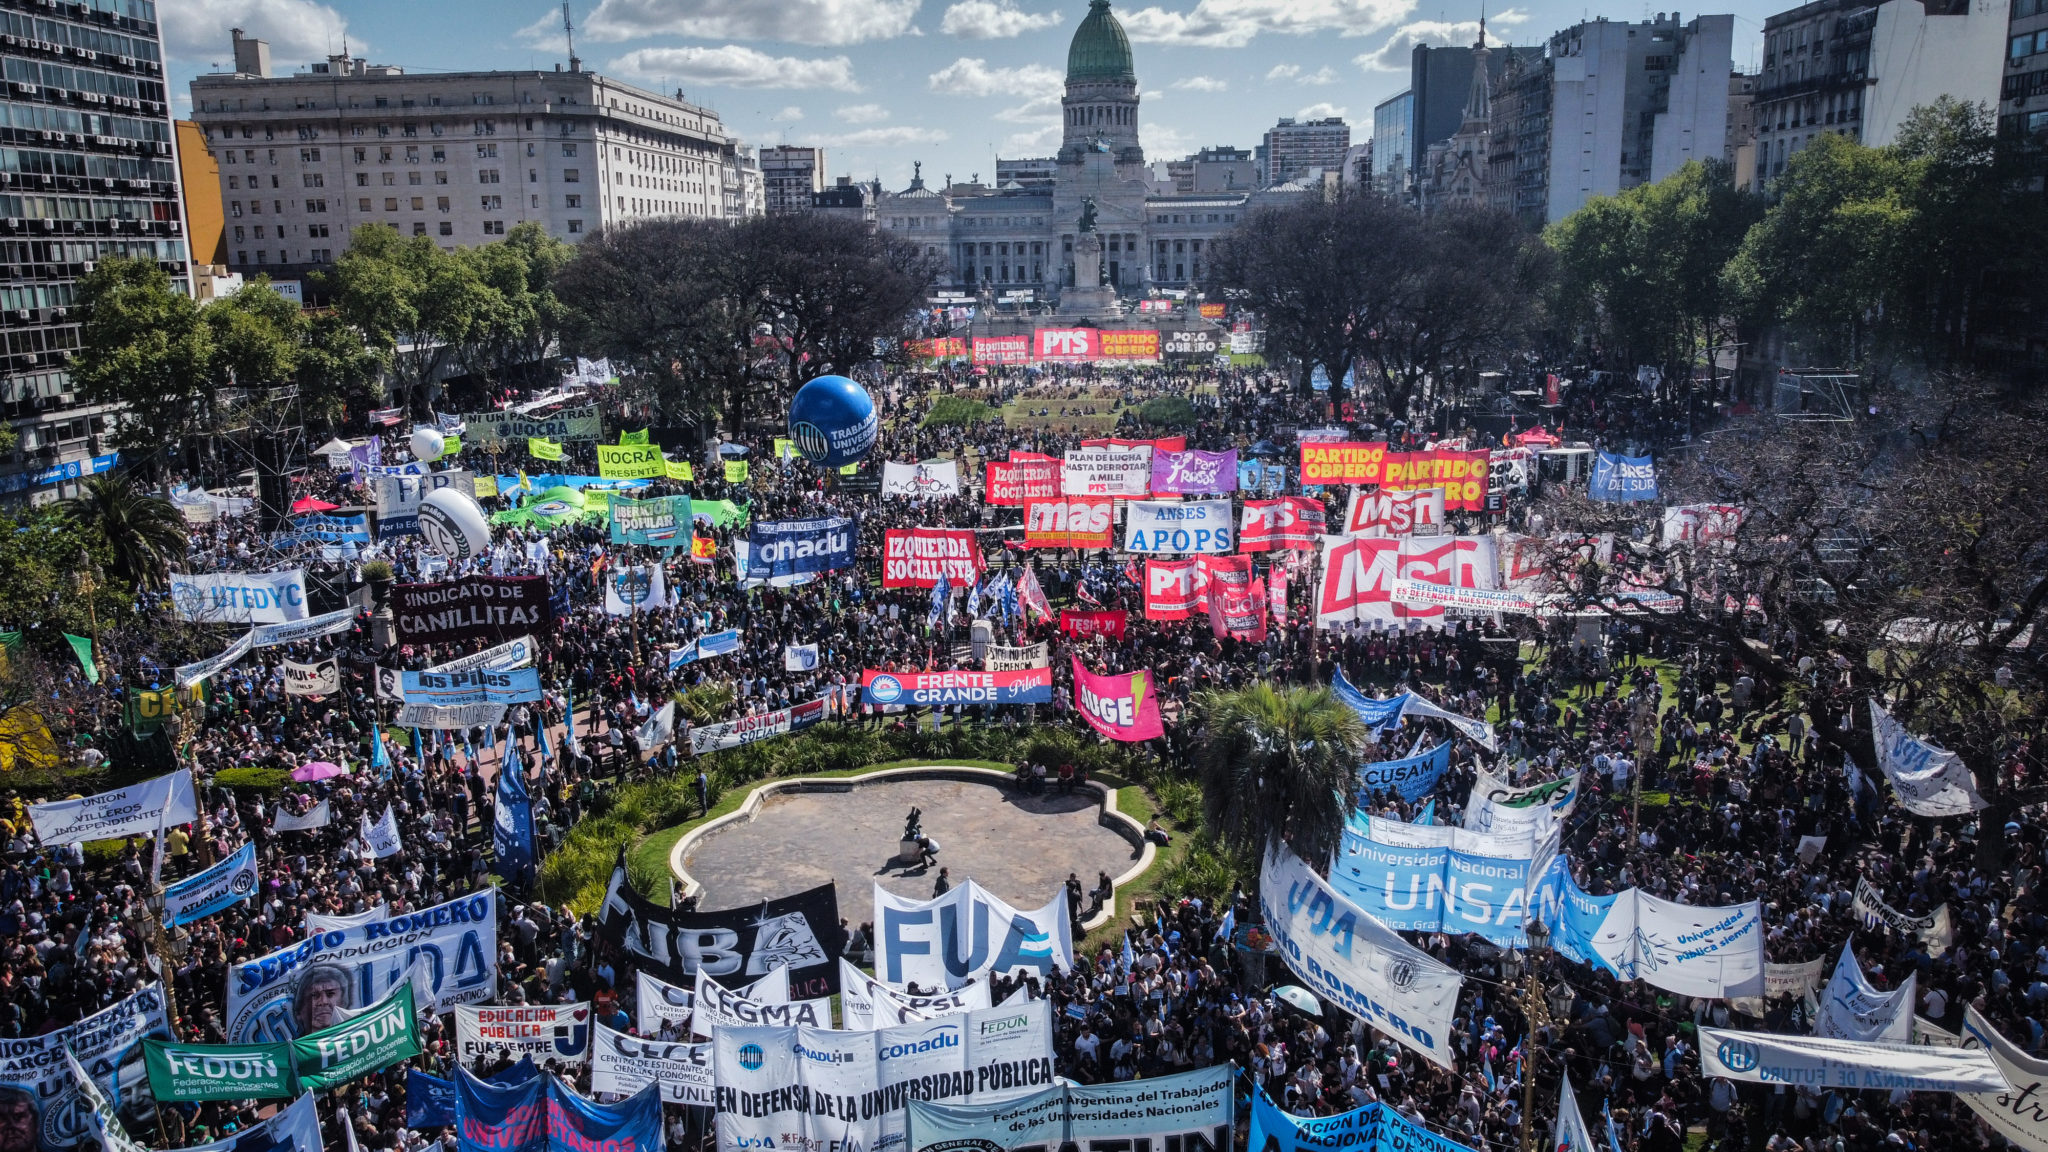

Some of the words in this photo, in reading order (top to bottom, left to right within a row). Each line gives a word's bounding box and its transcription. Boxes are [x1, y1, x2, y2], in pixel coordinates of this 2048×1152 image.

[975, 341, 1026, 352] IZQUIERDA
[1043, 331, 1089, 355] PTS
[1102, 333, 1158, 345] PARTIDO
[1105, 345, 1156, 355] OBRERO
[486, 413, 505, 423] UN
[513, 421, 568, 437] UOCRA
[601, 451, 656, 465] UOCRA
[1303, 448, 1383, 464] PARTIDO
[604, 466, 659, 478] PRESENTE
[995, 467, 1051, 483] IZQUIERDA
[1306, 463, 1379, 479] OBRERO
[1385, 458, 1488, 482] PARTIDO
[993, 483, 1054, 499] SOCIALISTA
[1607, 479, 1626, 492] DEL
[1630, 478, 1655, 490] SUR
[1035, 502, 1112, 533] mas
[1155, 506, 1206, 521] ANSES
[1241, 502, 1294, 530] PTS
[1350, 489, 1435, 531] MST
[620, 516, 676, 535] POPULAR
[888, 536, 970, 560] IZQUIERDA
[1129, 527, 1230, 551] APOPS
[887, 559, 973, 580] SOCIALISTA
[1150, 560, 1208, 597] PTS
[1328, 541, 1478, 614] MST
[210, 583, 302, 610] UTEDYC
[404, 582, 494, 607] SINDICATO
[500, 585, 524, 599] DE
[1410, 581, 1456, 595] DEFENDER
[1410, 588, 1456, 602] DEFENDER
[1458, 595, 1500, 607] NUESTRO
[400, 604, 540, 634] CANILLITAS
[1444, 606, 1494, 617] IZQUIERDA
[278, 628, 305, 638] SERGIO
[449, 652, 490, 672] UNIVERSIDAD
[451, 668, 511, 687] Pibes
[917, 673, 994, 689] FRENTE
[1008, 674, 1042, 698] Pilar
[913, 687, 997, 703] GRANDE
[1080, 683, 1134, 727] AUGE
[739, 725, 780, 744] SOCIAL
[1365, 757, 1434, 785] CUSAM
[81, 791, 127, 807] UNION
[54, 807, 165, 836] INDEPENDIENTES
[76, 803, 143, 823] VILLEROS
[1449, 857, 1524, 880] Nacional
[178, 889, 201, 901] ARTURO
[1385, 871, 1565, 927] UNSAM
[1286, 878, 1358, 962] UDA
[1677, 908, 1744, 945] Universidad
[883, 899, 1055, 984] FUA
[1719, 915, 1759, 948] siempre
[238, 930, 346, 997] SERGIO
[363, 892, 489, 941] ROMERO
[1675, 944, 1718, 964] pública
[441, 987, 488, 1008] ARGENTINOS
[701, 979, 819, 1028] CEGMA
[1306, 954, 1435, 1050] ROMERO
[478, 1006, 556, 1023] EDUCACIÓN
[480, 1023, 541, 1039] PÚBLICA
[980, 1015, 1028, 1036] FEDUN
[317, 1006, 406, 1069] FEDUN
[376, 1035, 408, 1055] Docentes
[494, 1041, 552, 1054] SIEMPRE
[878, 1032, 959, 1062] conadu
[164, 1048, 278, 1079] FEDUN
[600, 1054, 635, 1066] CENTRO
[651, 1061, 704, 1075] ESTUDIANTES
[739, 1044, 764, 1069] FATUN
[716, 1085, 738, 1115] EN
[741, 1084, 812, 1119] DEFENSA
[815, 1089, 836, 1117] DE
[836, 1095, 858, 1123] LA
[861, 1070, 974, 1121] UNIVERSIDAD
[978, 1057, 1053, 1092] PÚBLICA
[993, 1096, 1063, 1123] Federación
[1067, 1089, 1134, 1108] Argentina
[1136, 1089, 1158, 1102] del
[1160, 1078, 1232, 1100] Trabajador
[1008, 1118, 1026, 1132] de
[1028, 1115, 1046, 1128] las
[1048, 1109, 1144, 1124] Universidades
[1146, 1098, 1219, 1117] Nacionales
[1358, 1107, 1386, 1127] DEL
[933, 1138, 984, 1150] GENERAL
[1295, 1126, 1387, 1148] NACIONAL
